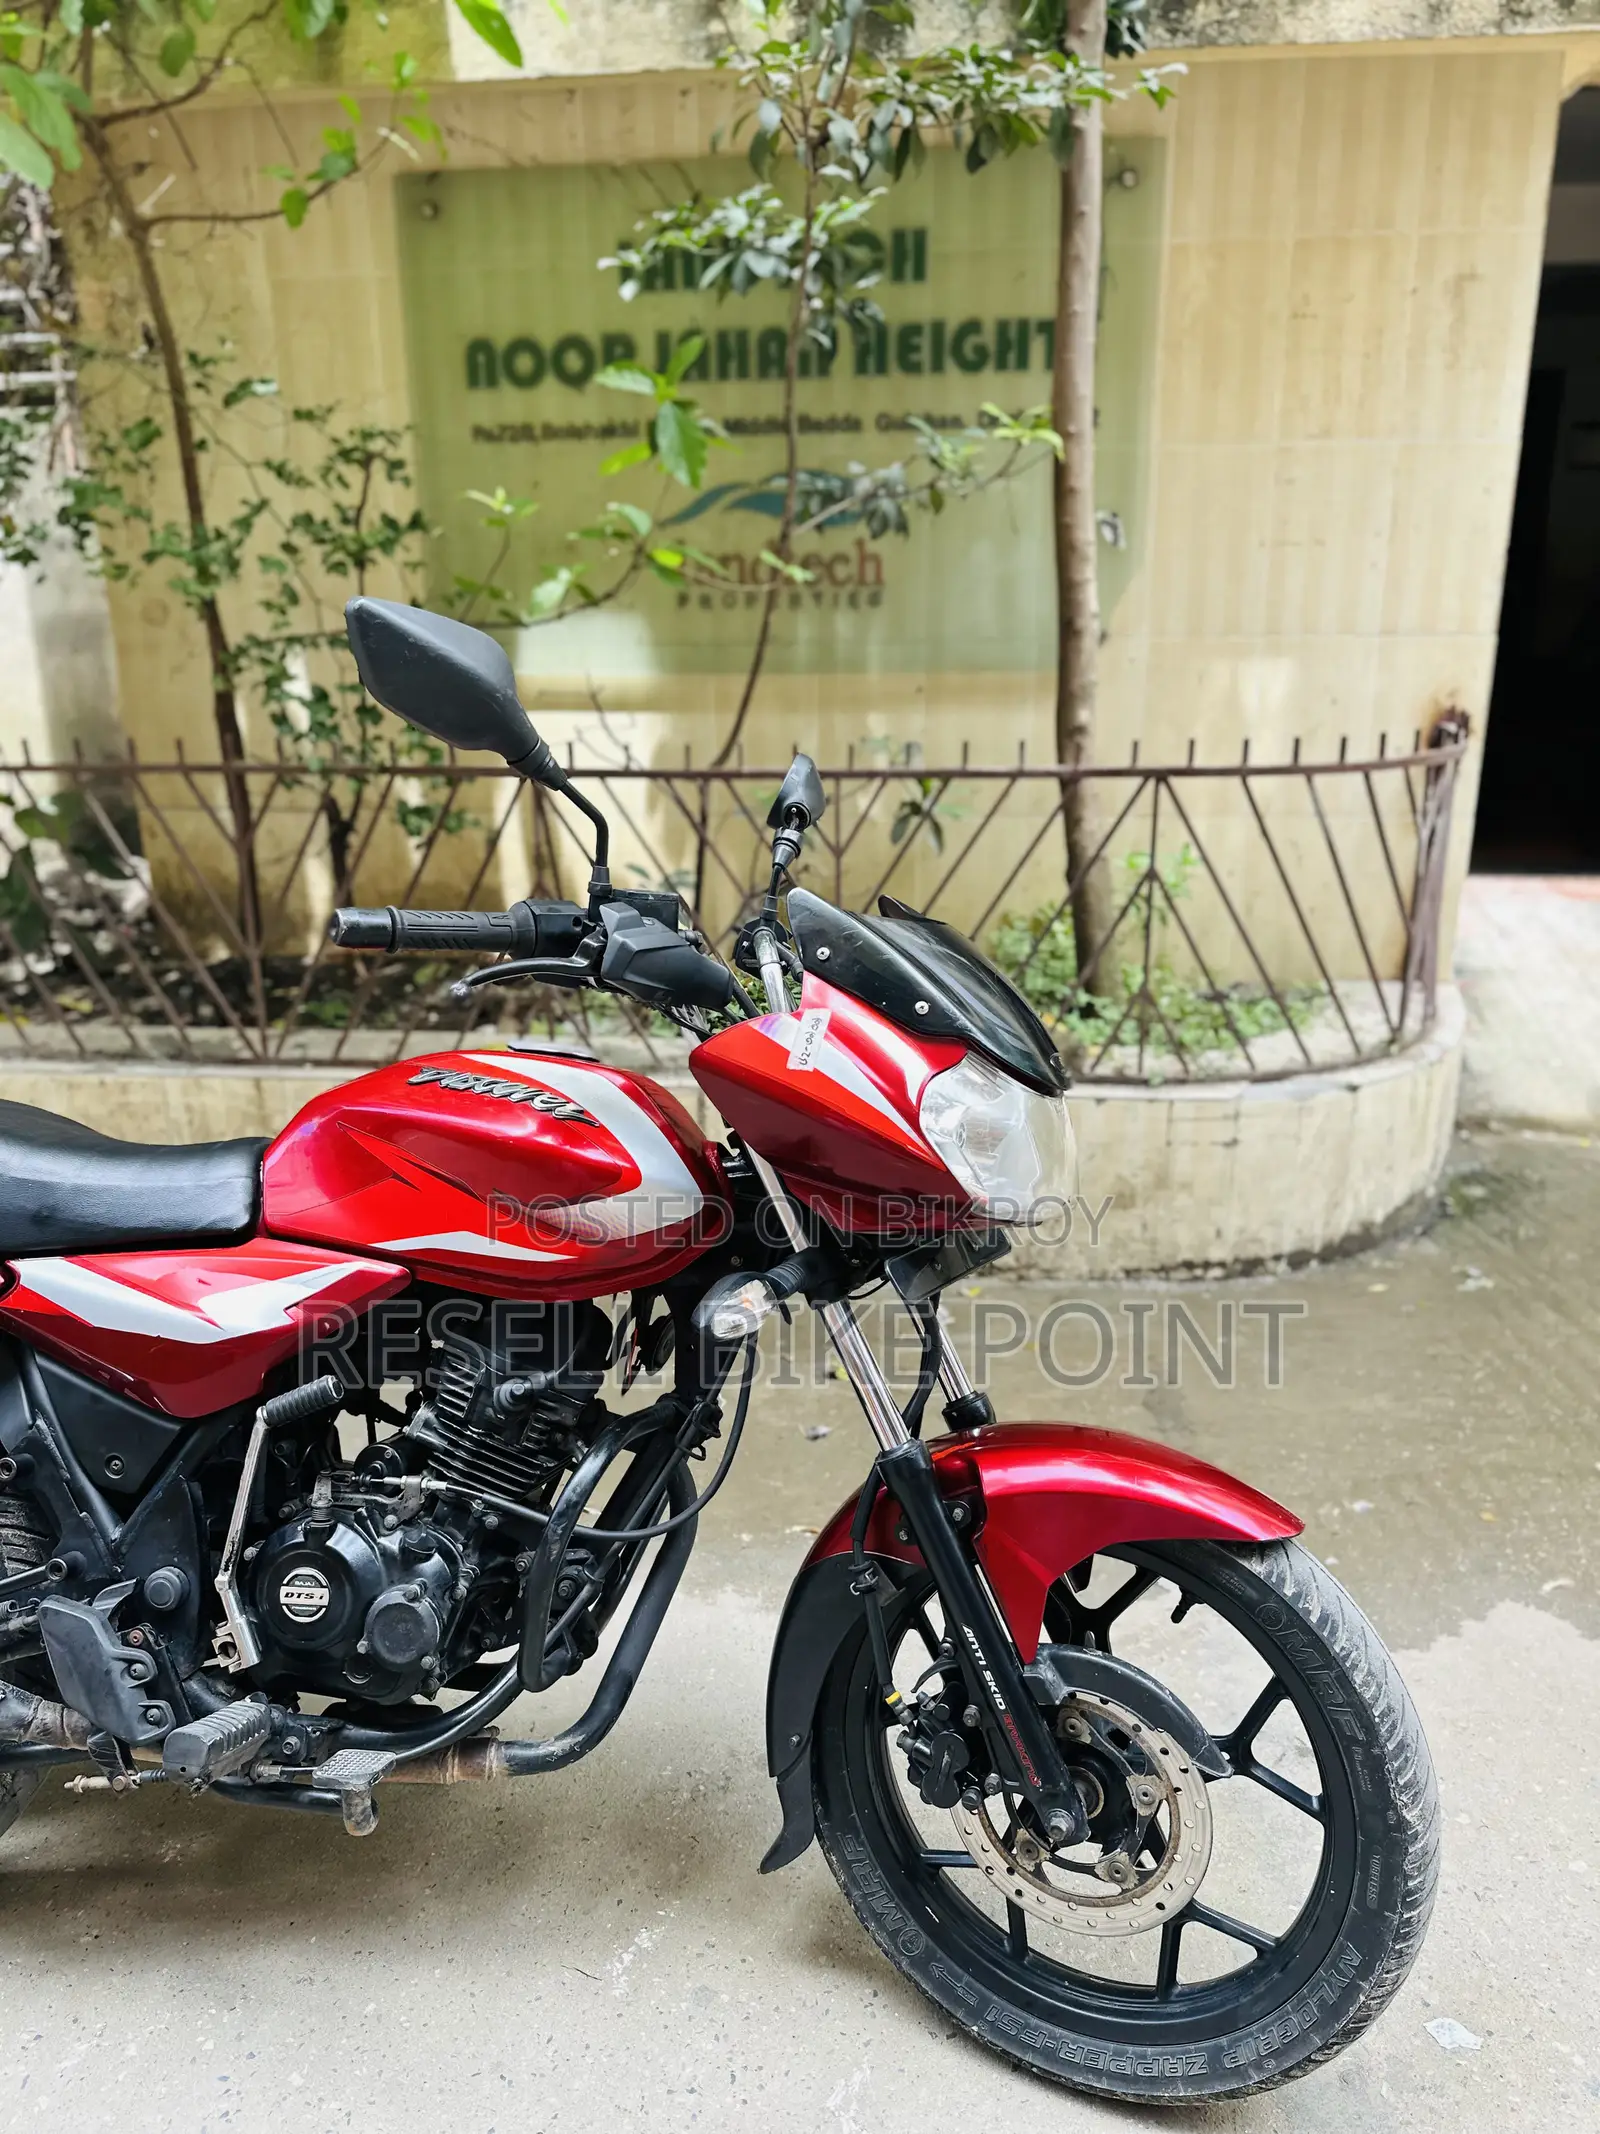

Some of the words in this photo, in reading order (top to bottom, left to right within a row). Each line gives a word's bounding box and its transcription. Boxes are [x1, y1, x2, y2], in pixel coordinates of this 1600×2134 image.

[284, 1591, 325, 1600] DTS-i
[960, 1622, 987, 1666] ANTI
[982, 1670, 1006, 1711] SKID
[1275, 1629, 1367, 1742] MRF
[838, 1832, 907, 1932] MRF
